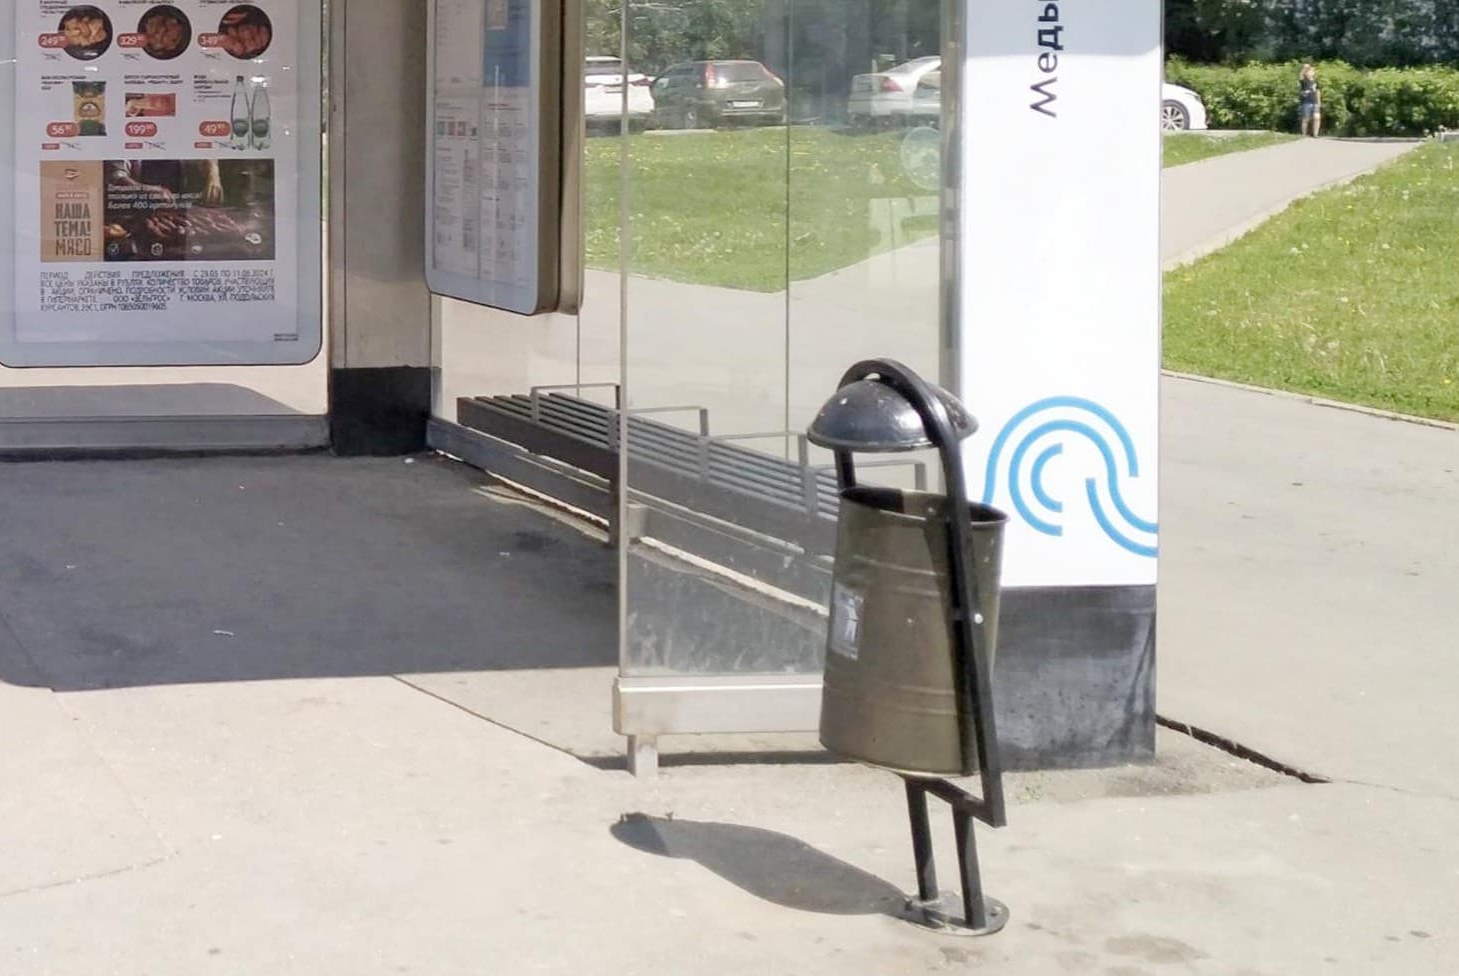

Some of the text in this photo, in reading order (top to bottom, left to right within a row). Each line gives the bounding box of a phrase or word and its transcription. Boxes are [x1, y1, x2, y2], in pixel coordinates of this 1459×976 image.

[55, 203, 91, 220] НАША
[54, 221, 92, 237] ТЕМА!
[55, 238, 92, 256] МЯСО
